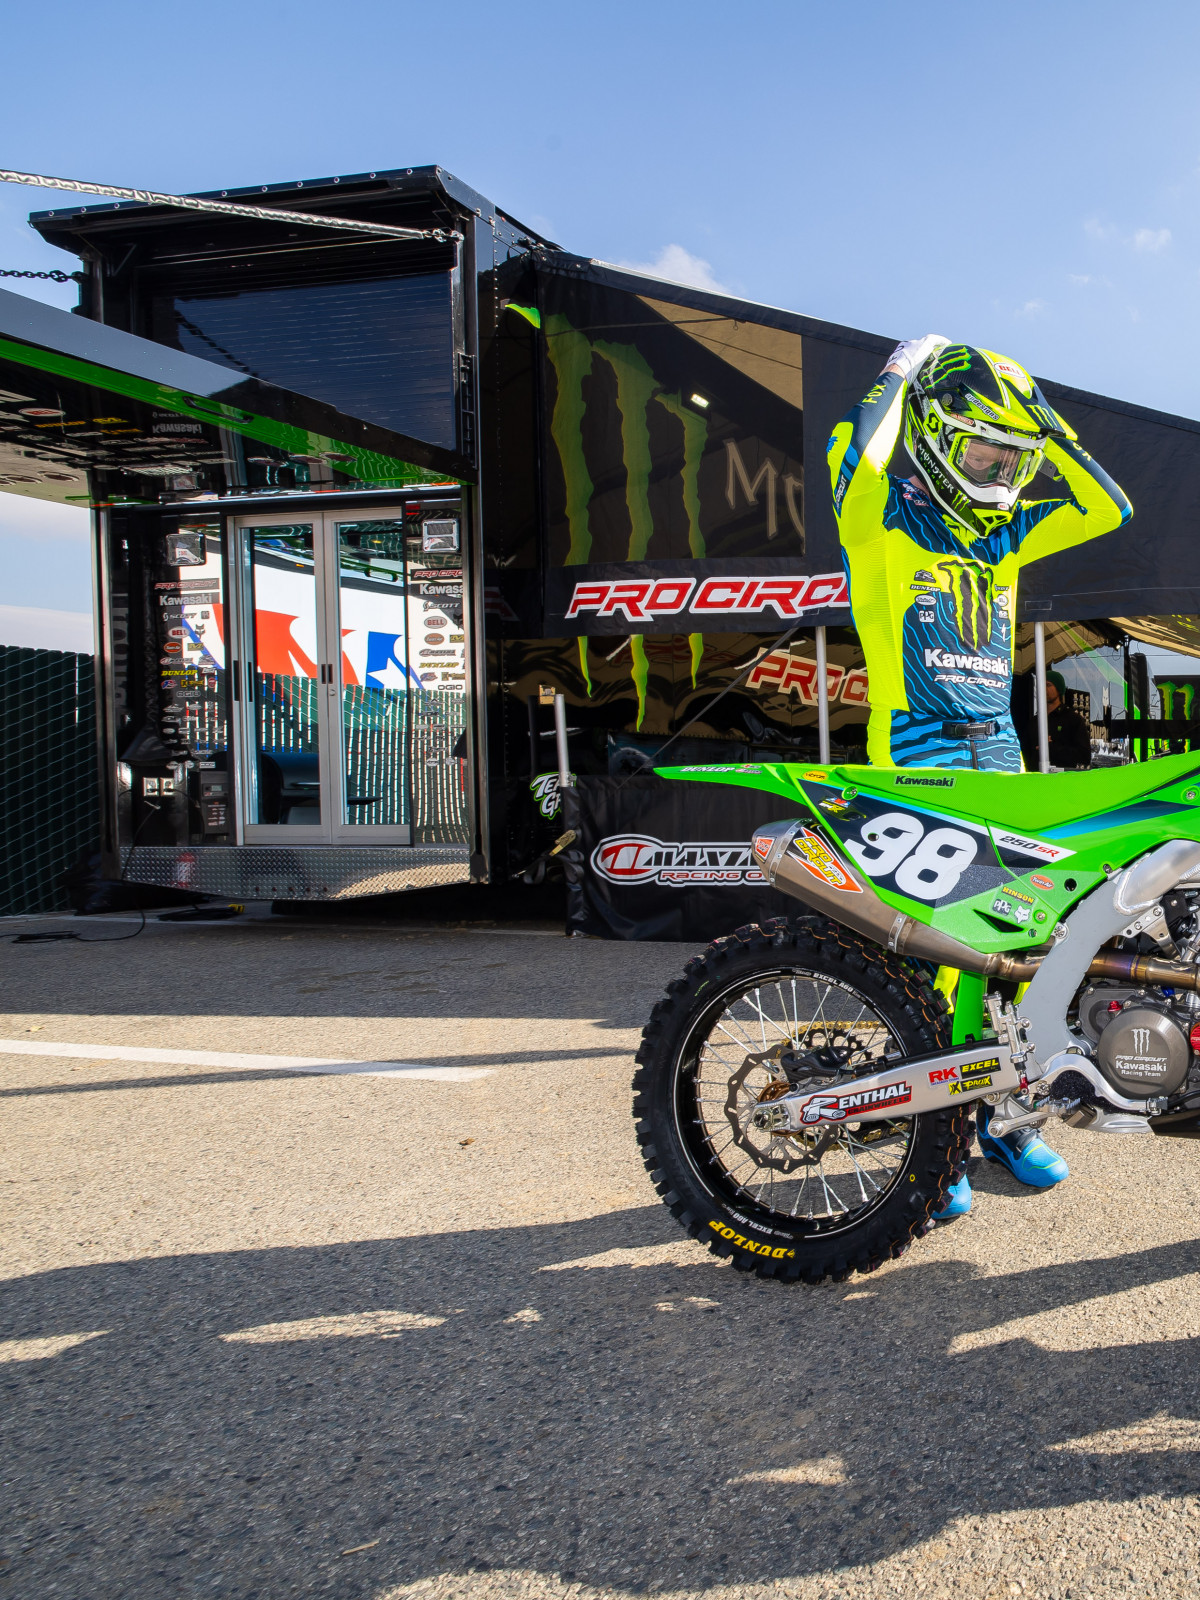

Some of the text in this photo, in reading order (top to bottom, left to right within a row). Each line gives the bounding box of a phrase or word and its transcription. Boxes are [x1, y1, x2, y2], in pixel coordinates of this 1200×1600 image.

[863, 383, 887, 404] FOX
[917, 442, 955, 494] MONSTER
[564, 571, 851, 622] PRO CIRC
[910, 584, 941, 592] DUNLOP
[160, 593, 213, 606] Kawasaki
[924, 648, 1009, 677] Kawasaki
[161, 669, 198, 677] DUNLOP
[745, 646, 846, 707] PRO
[933, 674, 1007, 690] PRO CIRCUIT
[895, 775, 955, 788] Kawasaki
[805, 837, 832, 863] PRO
[843, 812, 978, 900] 98
[795, 839, 843, 885] CIRCUIT
[1002, 886, 1035, 904] HINSON
[961, 1058, 999, 1073] EXCEL
[1115, 1060, 1167, 1072] Kawasaki
[1121, 1069, 1143, 1077] Racing
[928, 1066, 959, 1083] RK
[748, 1219, 774, 1235] EXCEL
[708, 1220, 789, 1259] DUNLOP
